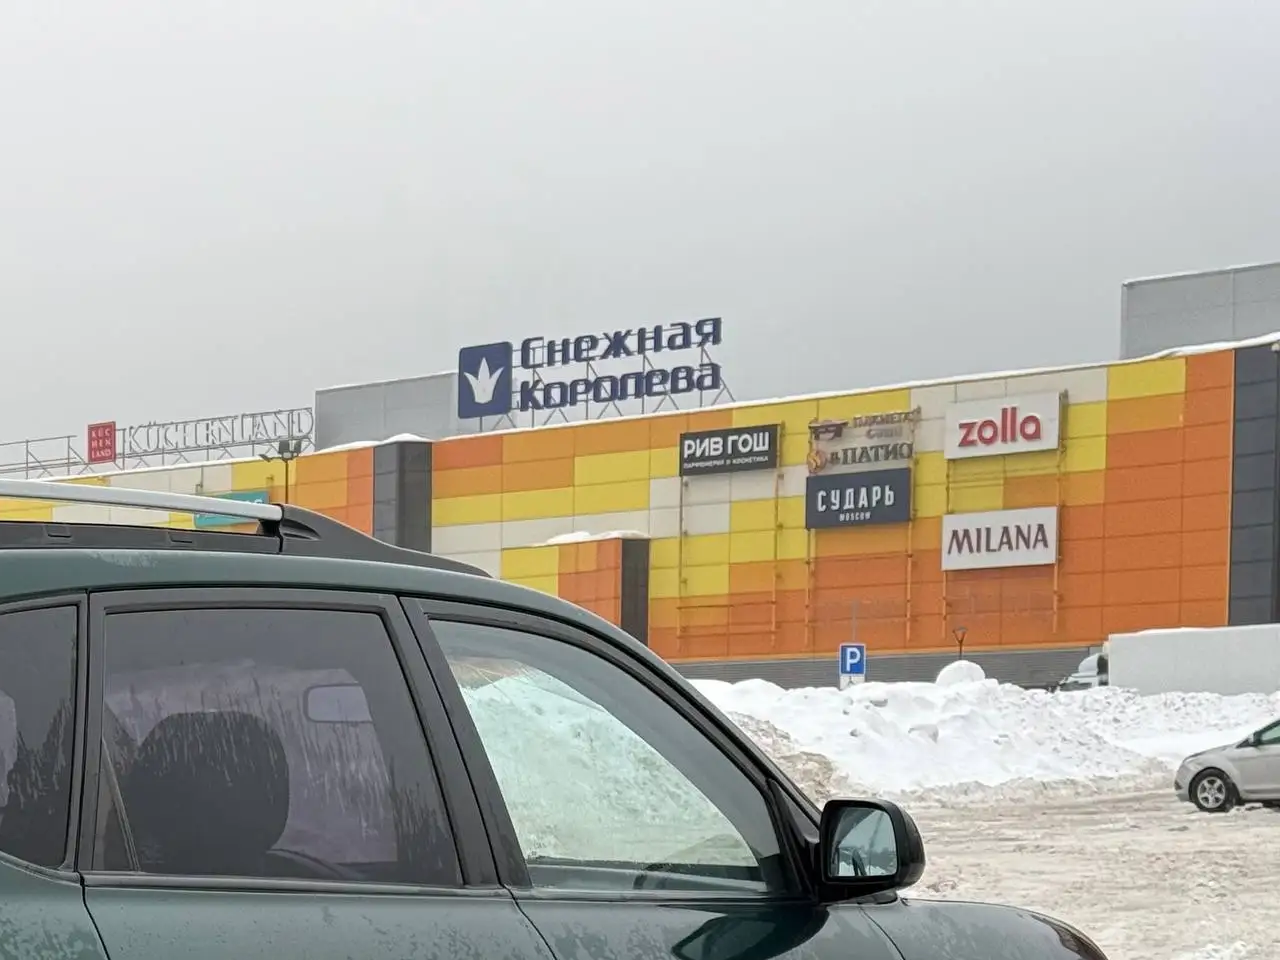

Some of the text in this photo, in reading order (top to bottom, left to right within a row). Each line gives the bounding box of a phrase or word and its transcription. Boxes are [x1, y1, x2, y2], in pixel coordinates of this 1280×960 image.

[520, 317, 722, 370] Снежная
[520, 362, 722, 412] Королева
[958, 407, 1041, 447] zolla
[683, 432, 770, 458] РИВ ГОШ
[841, 442, 913, 465] ПАТИО
[817, 485, 895, 512] СУДАРЬ
[948, 523, 1049, 554] MILANA
[846, 647, 861, 672] P
